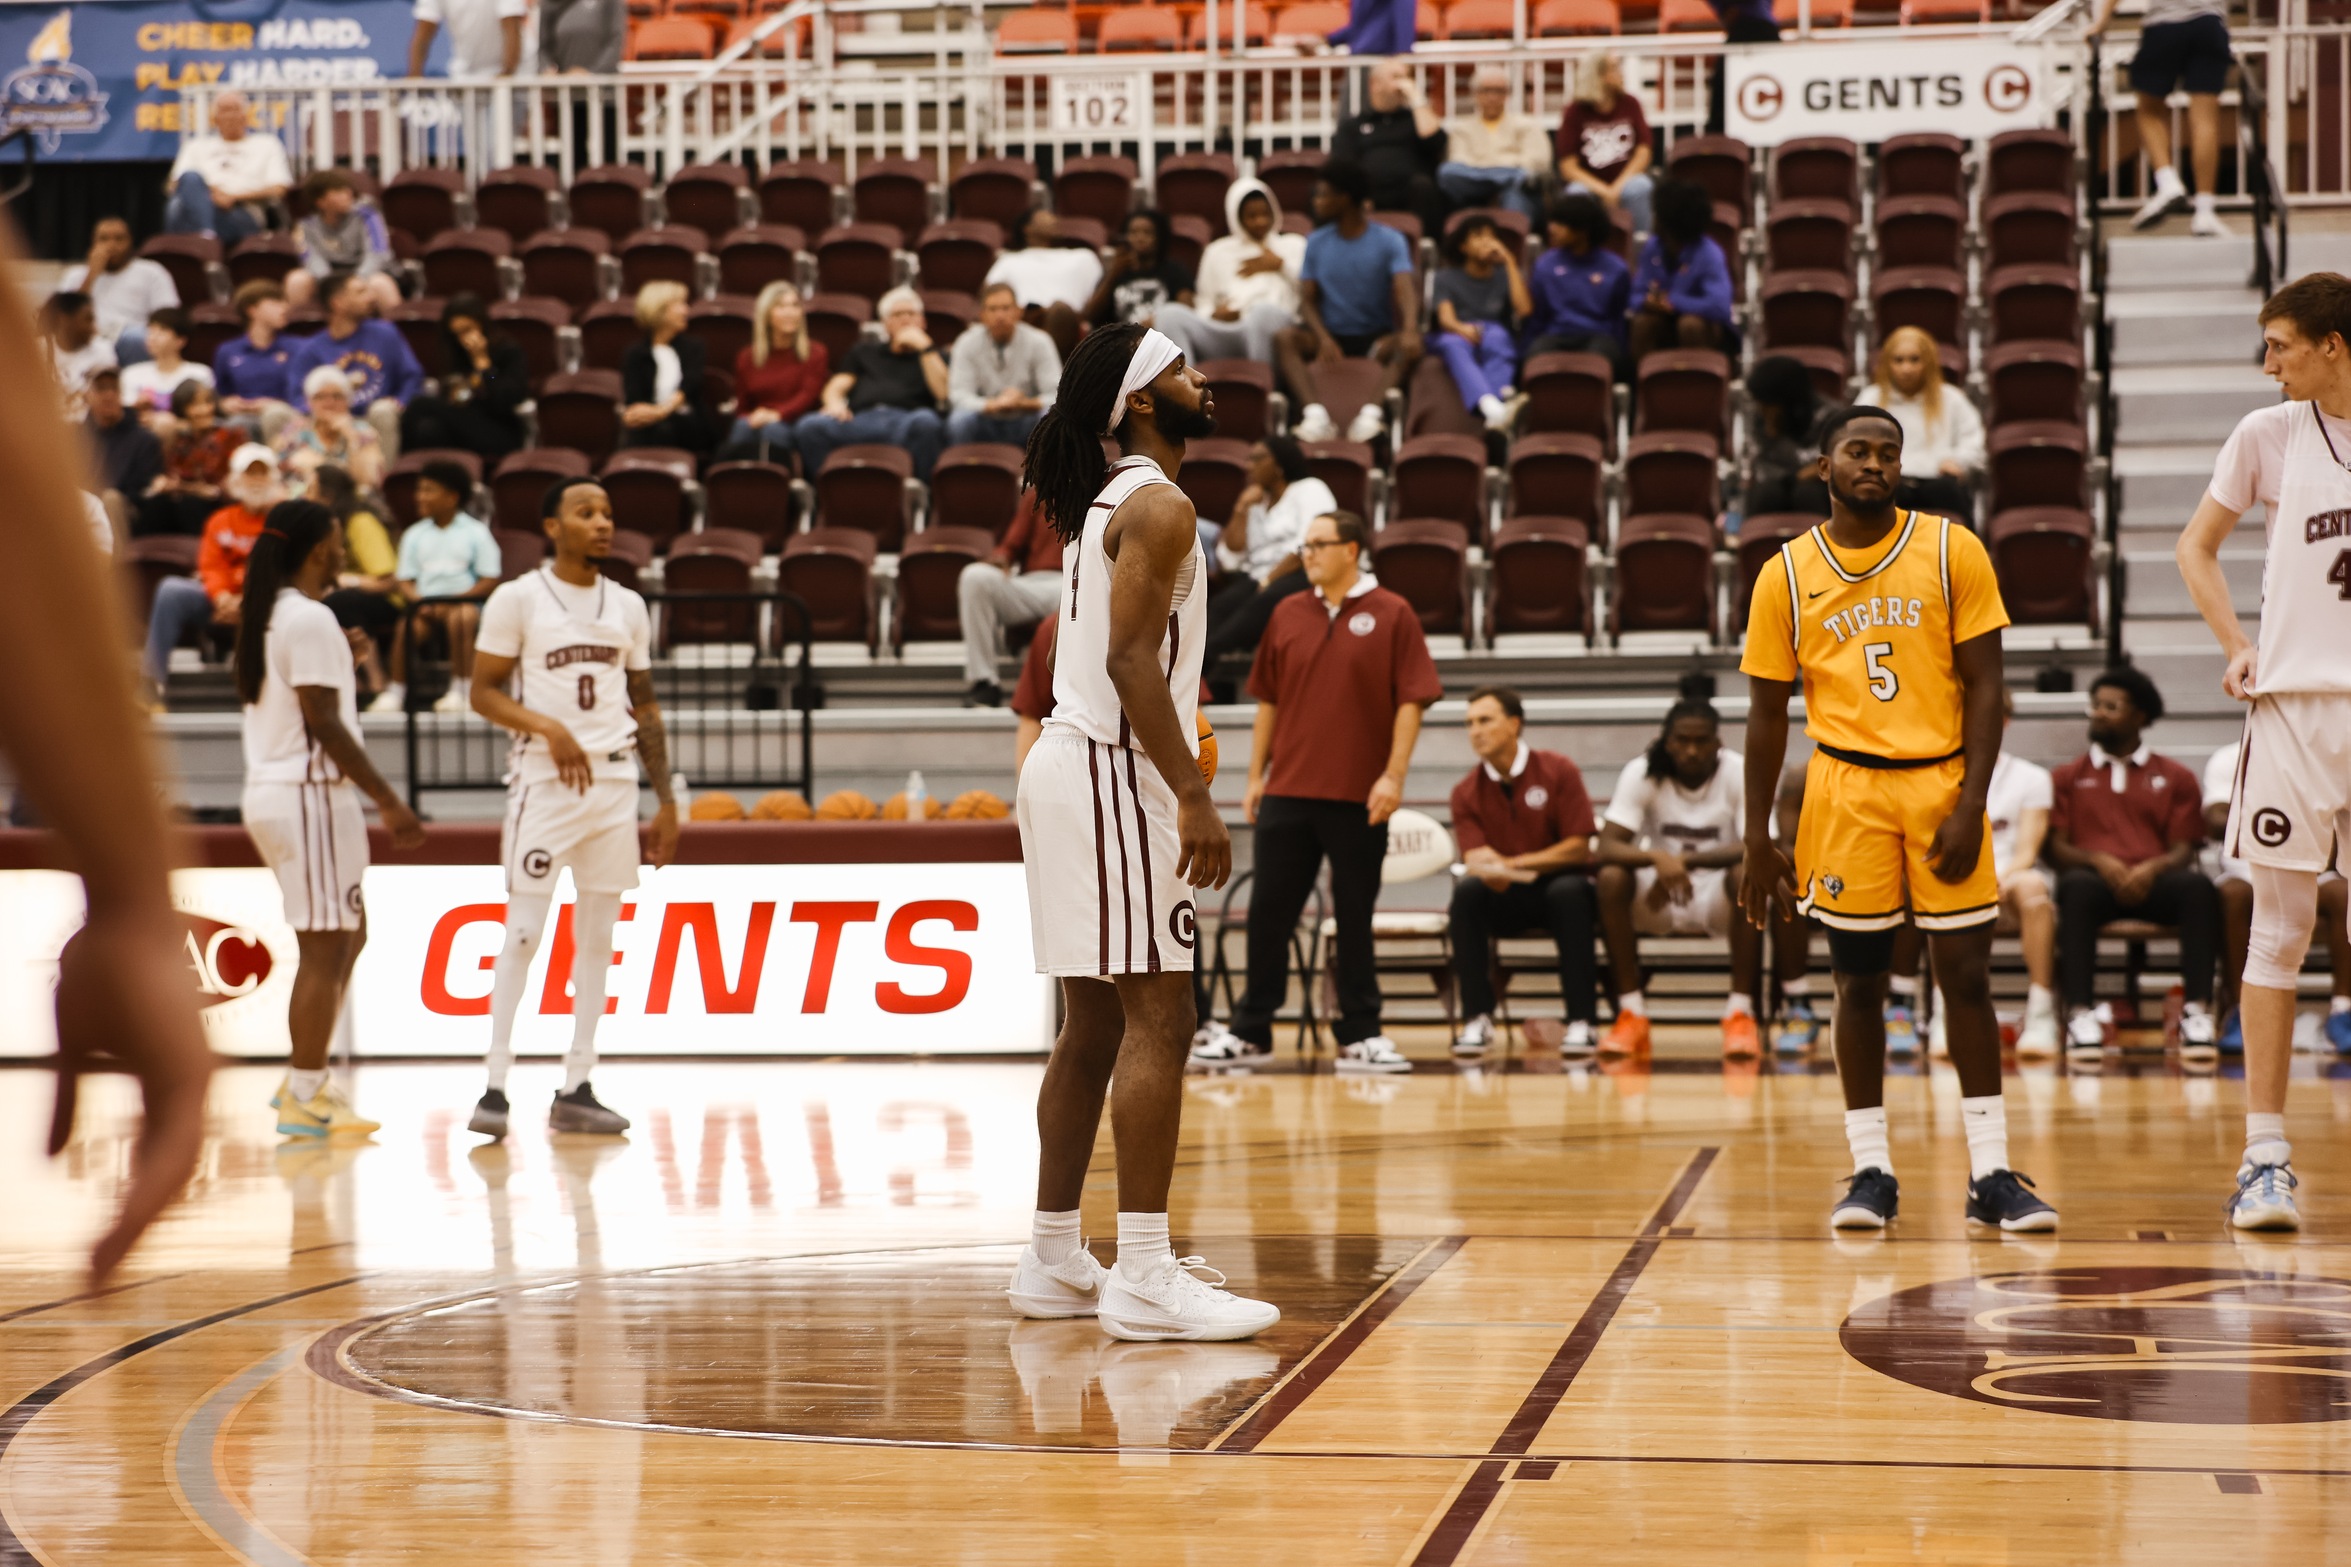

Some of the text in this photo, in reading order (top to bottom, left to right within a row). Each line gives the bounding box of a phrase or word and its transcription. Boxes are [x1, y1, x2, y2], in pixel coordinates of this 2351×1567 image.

[137, 18, 370, 51] CHEER HARD.
[136, 58, 386, 90] PLAY HARDER.
[1066, 97, 1127, 126] 102
[1805, 76, 1963, 111] GENTS
[1822, 597, 1922, 643] TIGERS
[1863, 642, 1899, 702] 5
[578, 674, 595, 711] 0
[420, 899, 979, 1016] GENTS
